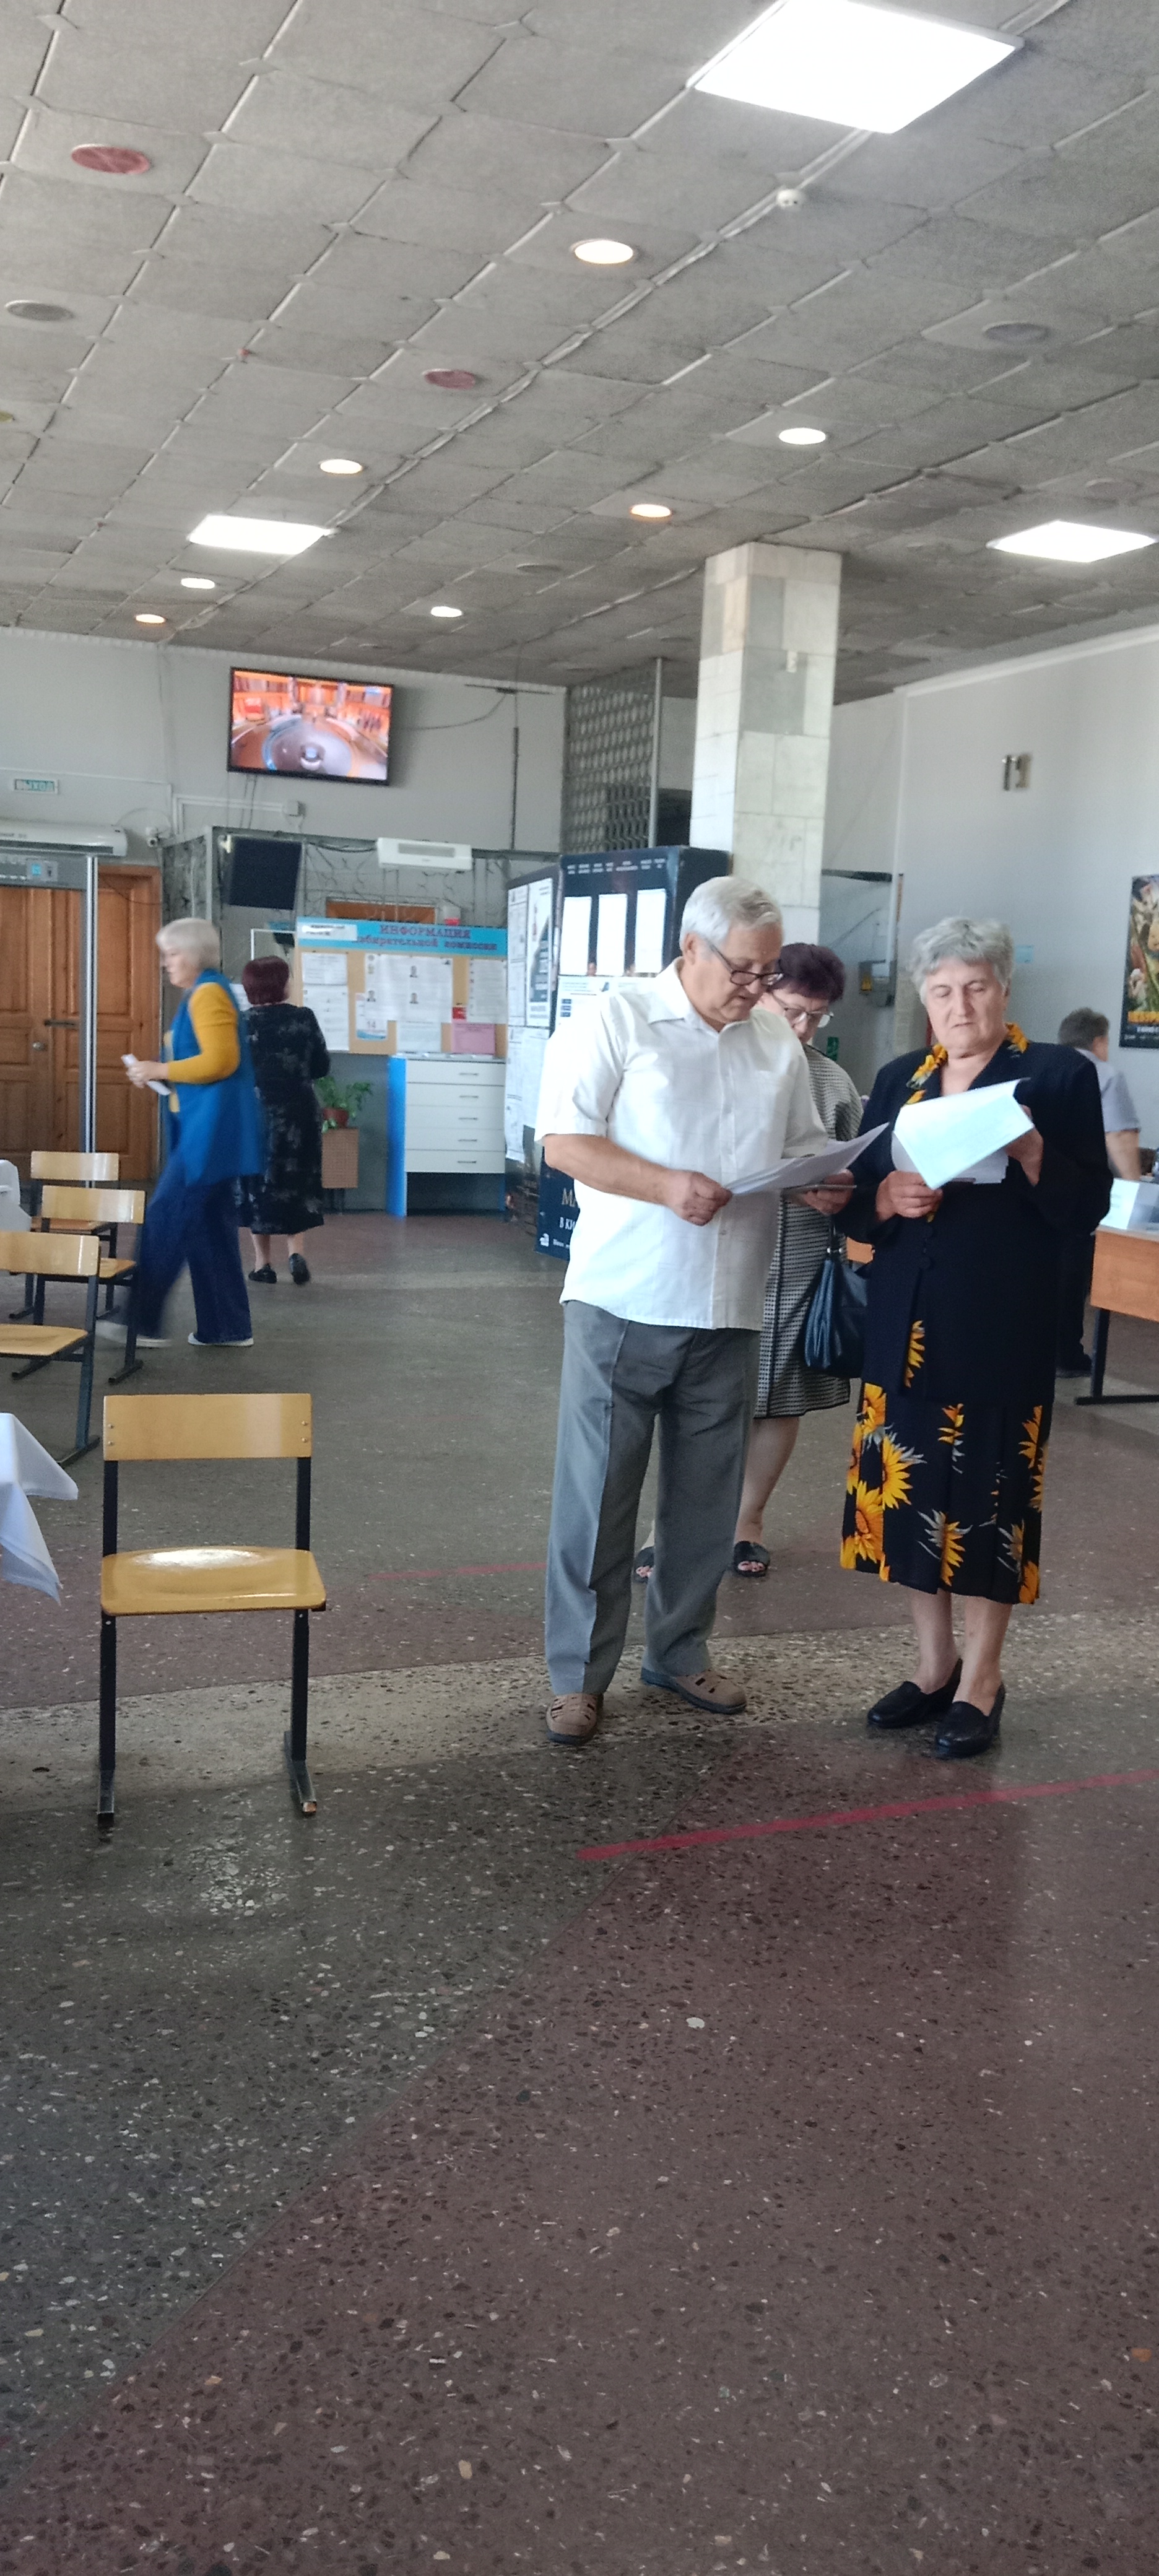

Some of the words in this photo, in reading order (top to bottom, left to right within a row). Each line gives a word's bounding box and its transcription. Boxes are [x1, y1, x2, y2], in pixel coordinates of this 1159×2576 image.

[17, 780, 54, 791] ЫХОД
[380, 925, 471, 939] ИНФОРМАЦИЯ
[352, 934, 438, 947] збирательной
